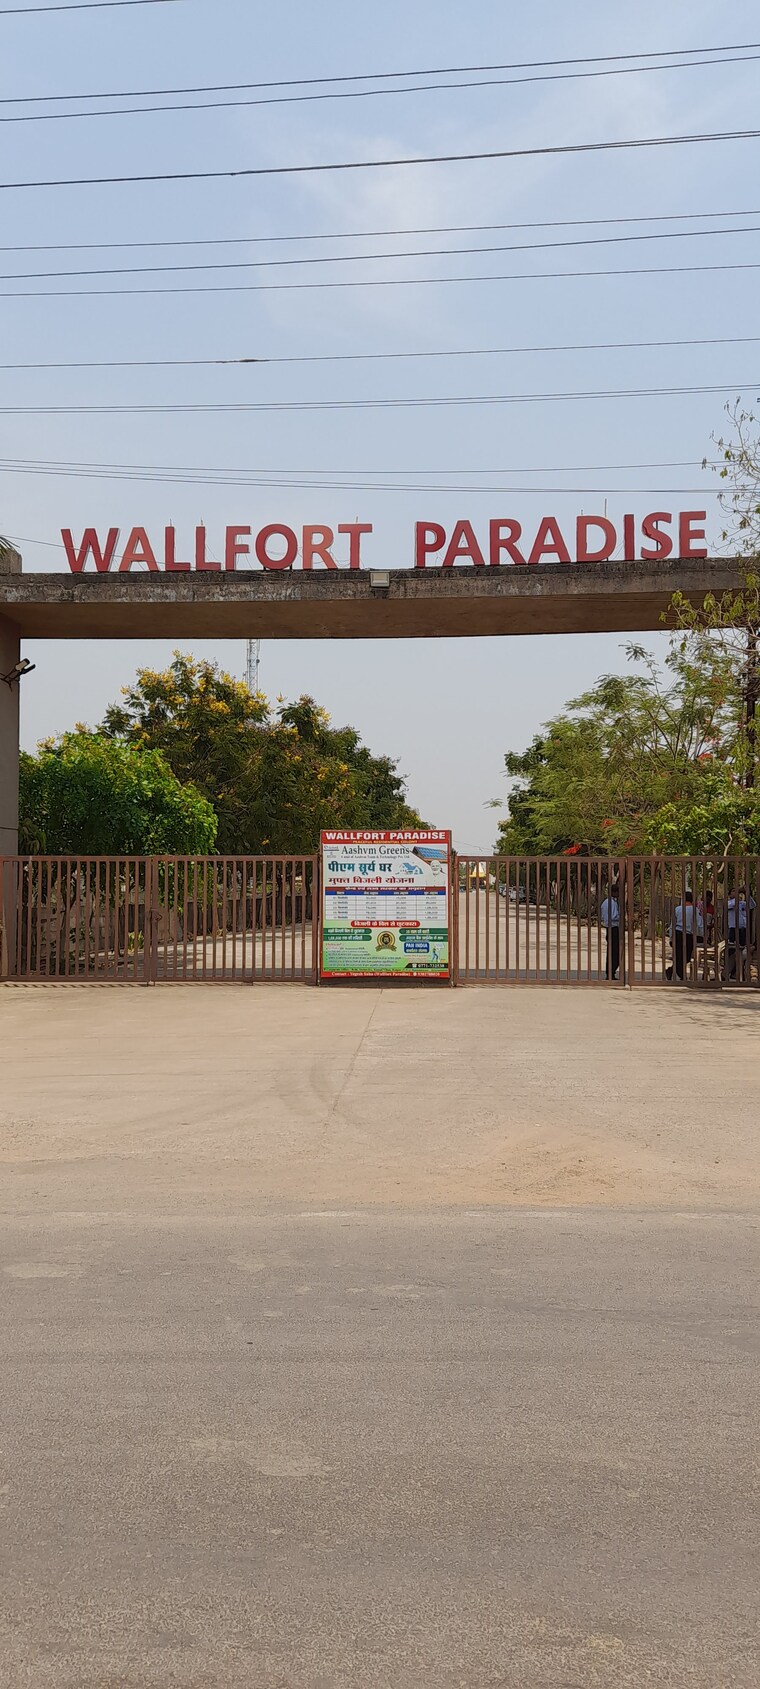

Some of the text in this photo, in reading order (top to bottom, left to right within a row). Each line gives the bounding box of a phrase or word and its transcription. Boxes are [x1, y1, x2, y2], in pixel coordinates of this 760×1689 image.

[60, 510, 707, 573] WALLFORT PARADISE
[325, 831, 446, 840] WALLFORT PARADISE
[341, 845, 377, 855] Aashvm
[379, 845, 410, 855] Greens
[328, 860, 392, 876] पीएम सूर्य घर
[385, 876, 415, 884] योजना
